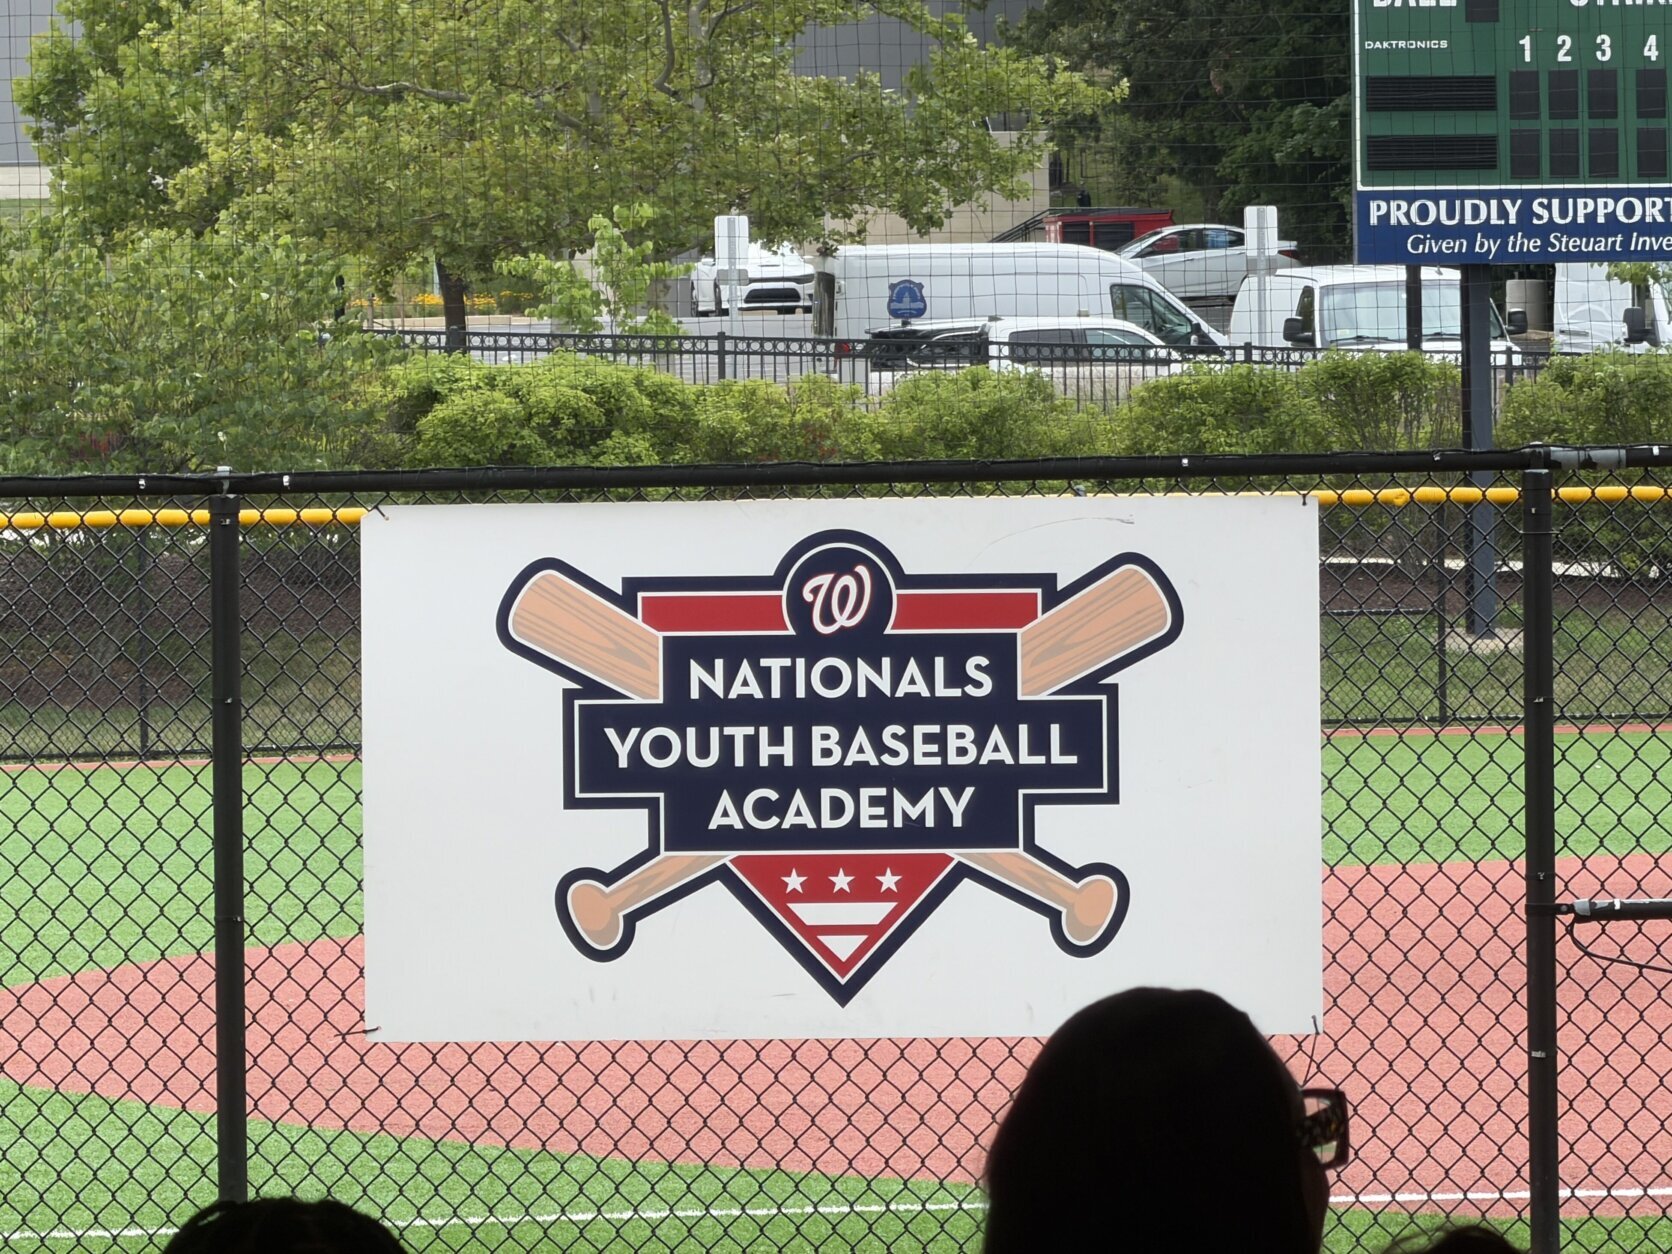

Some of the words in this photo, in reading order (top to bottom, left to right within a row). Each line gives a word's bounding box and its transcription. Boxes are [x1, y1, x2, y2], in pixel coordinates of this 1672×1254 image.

[1364, 40, 1448, 49] DAKTRONICS
[1519, 35, 1532, 62] 1
[1556, 35, 1572, 62] 2
[1595, 34, 1612, 62] 3
[1643, 34, 1659, 61] 4
[1369, 198, 1522, 226] PROUDLY
[1407, 234, 1467, 254] Given
[1475, 233, 1501, 259] by
[1507, 233, 1541, 253] the
[1547, 232, 1623, 252] Steuart
[802, 564, 872, 635] W
[689, 656, 993, 700] NATIONALS
[603, 724, 794, 768] YOUTH
[811, 723, 1078, 767] BASEBALL
[708, 786, 976, 830] ACADEMY
